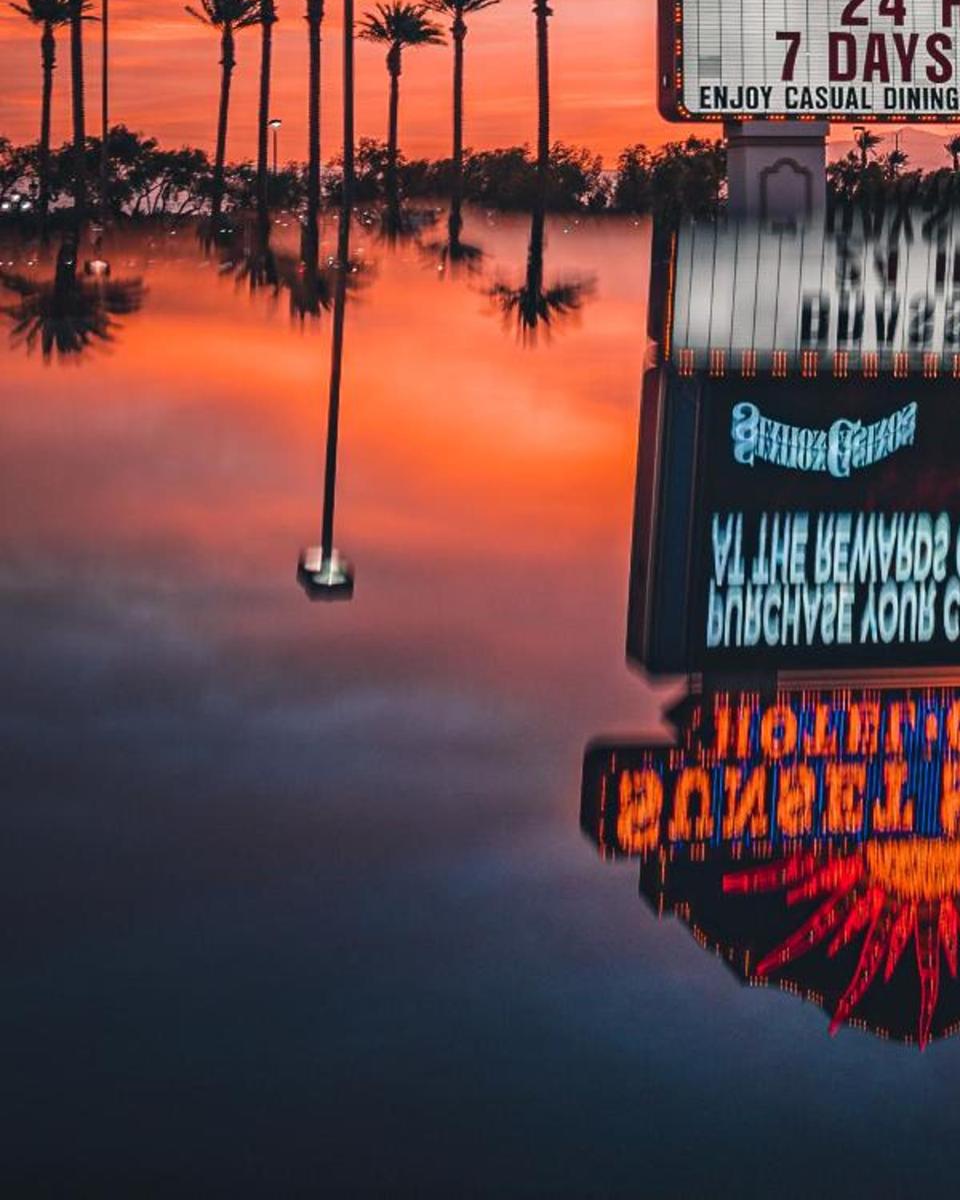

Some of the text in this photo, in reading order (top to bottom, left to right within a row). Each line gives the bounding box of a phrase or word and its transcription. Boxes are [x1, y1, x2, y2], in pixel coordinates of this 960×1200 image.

[774, 31, 802, 83] 7
[827, 31, 954, 84] DAYS
[699, 85, 773, 110] ENJOY
[785, 86, 872, 111] CASUAL
[884, 87, 960, 111] DINING
